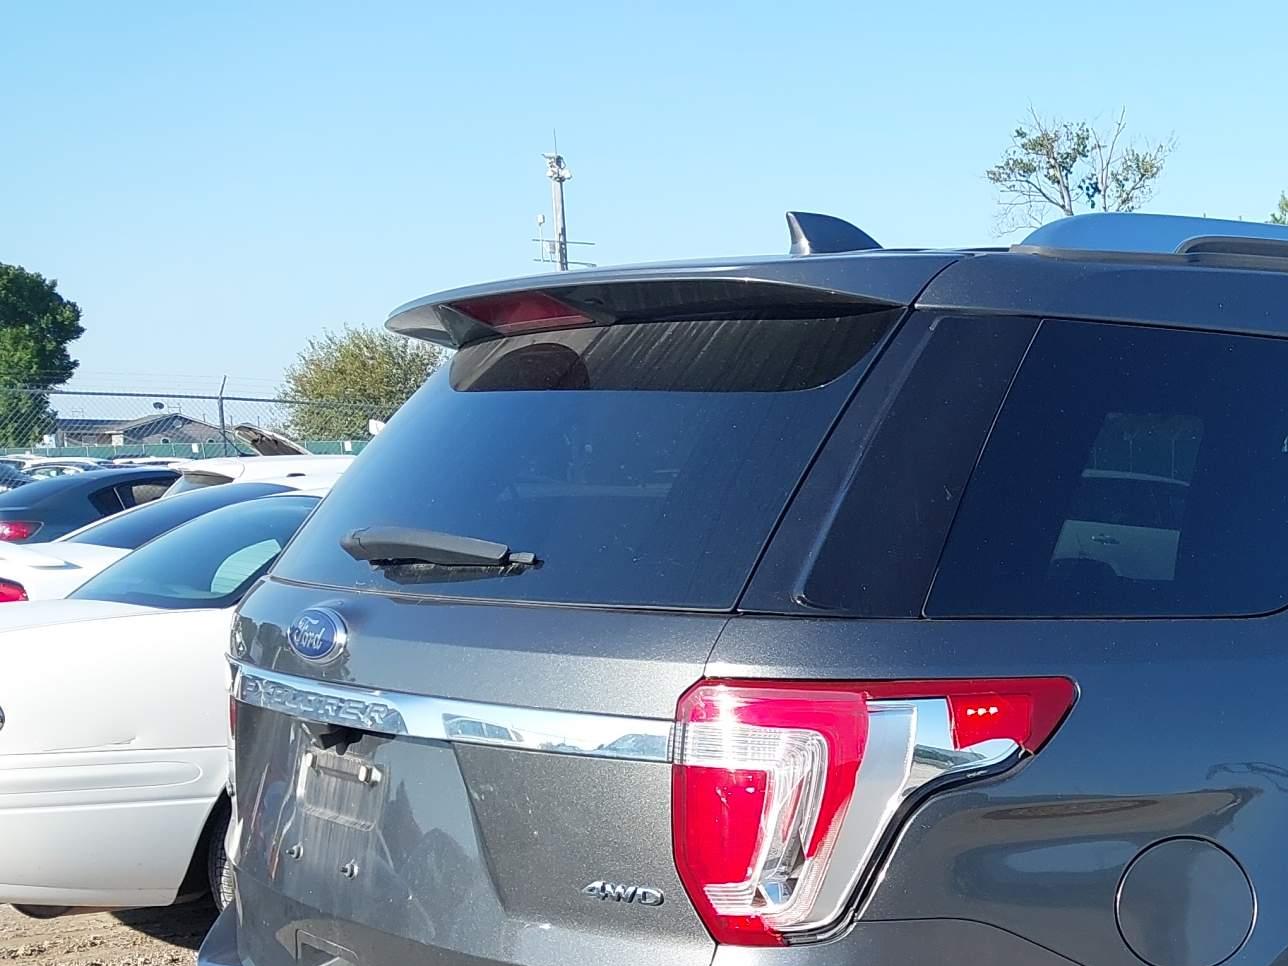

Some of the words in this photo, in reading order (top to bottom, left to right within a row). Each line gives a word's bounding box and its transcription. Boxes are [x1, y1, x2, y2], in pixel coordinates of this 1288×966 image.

[294, 616, 326, 650] Ford
[245, 676, 391, 727] EXPLORER
[582, 880, 664, 906] 4WD
